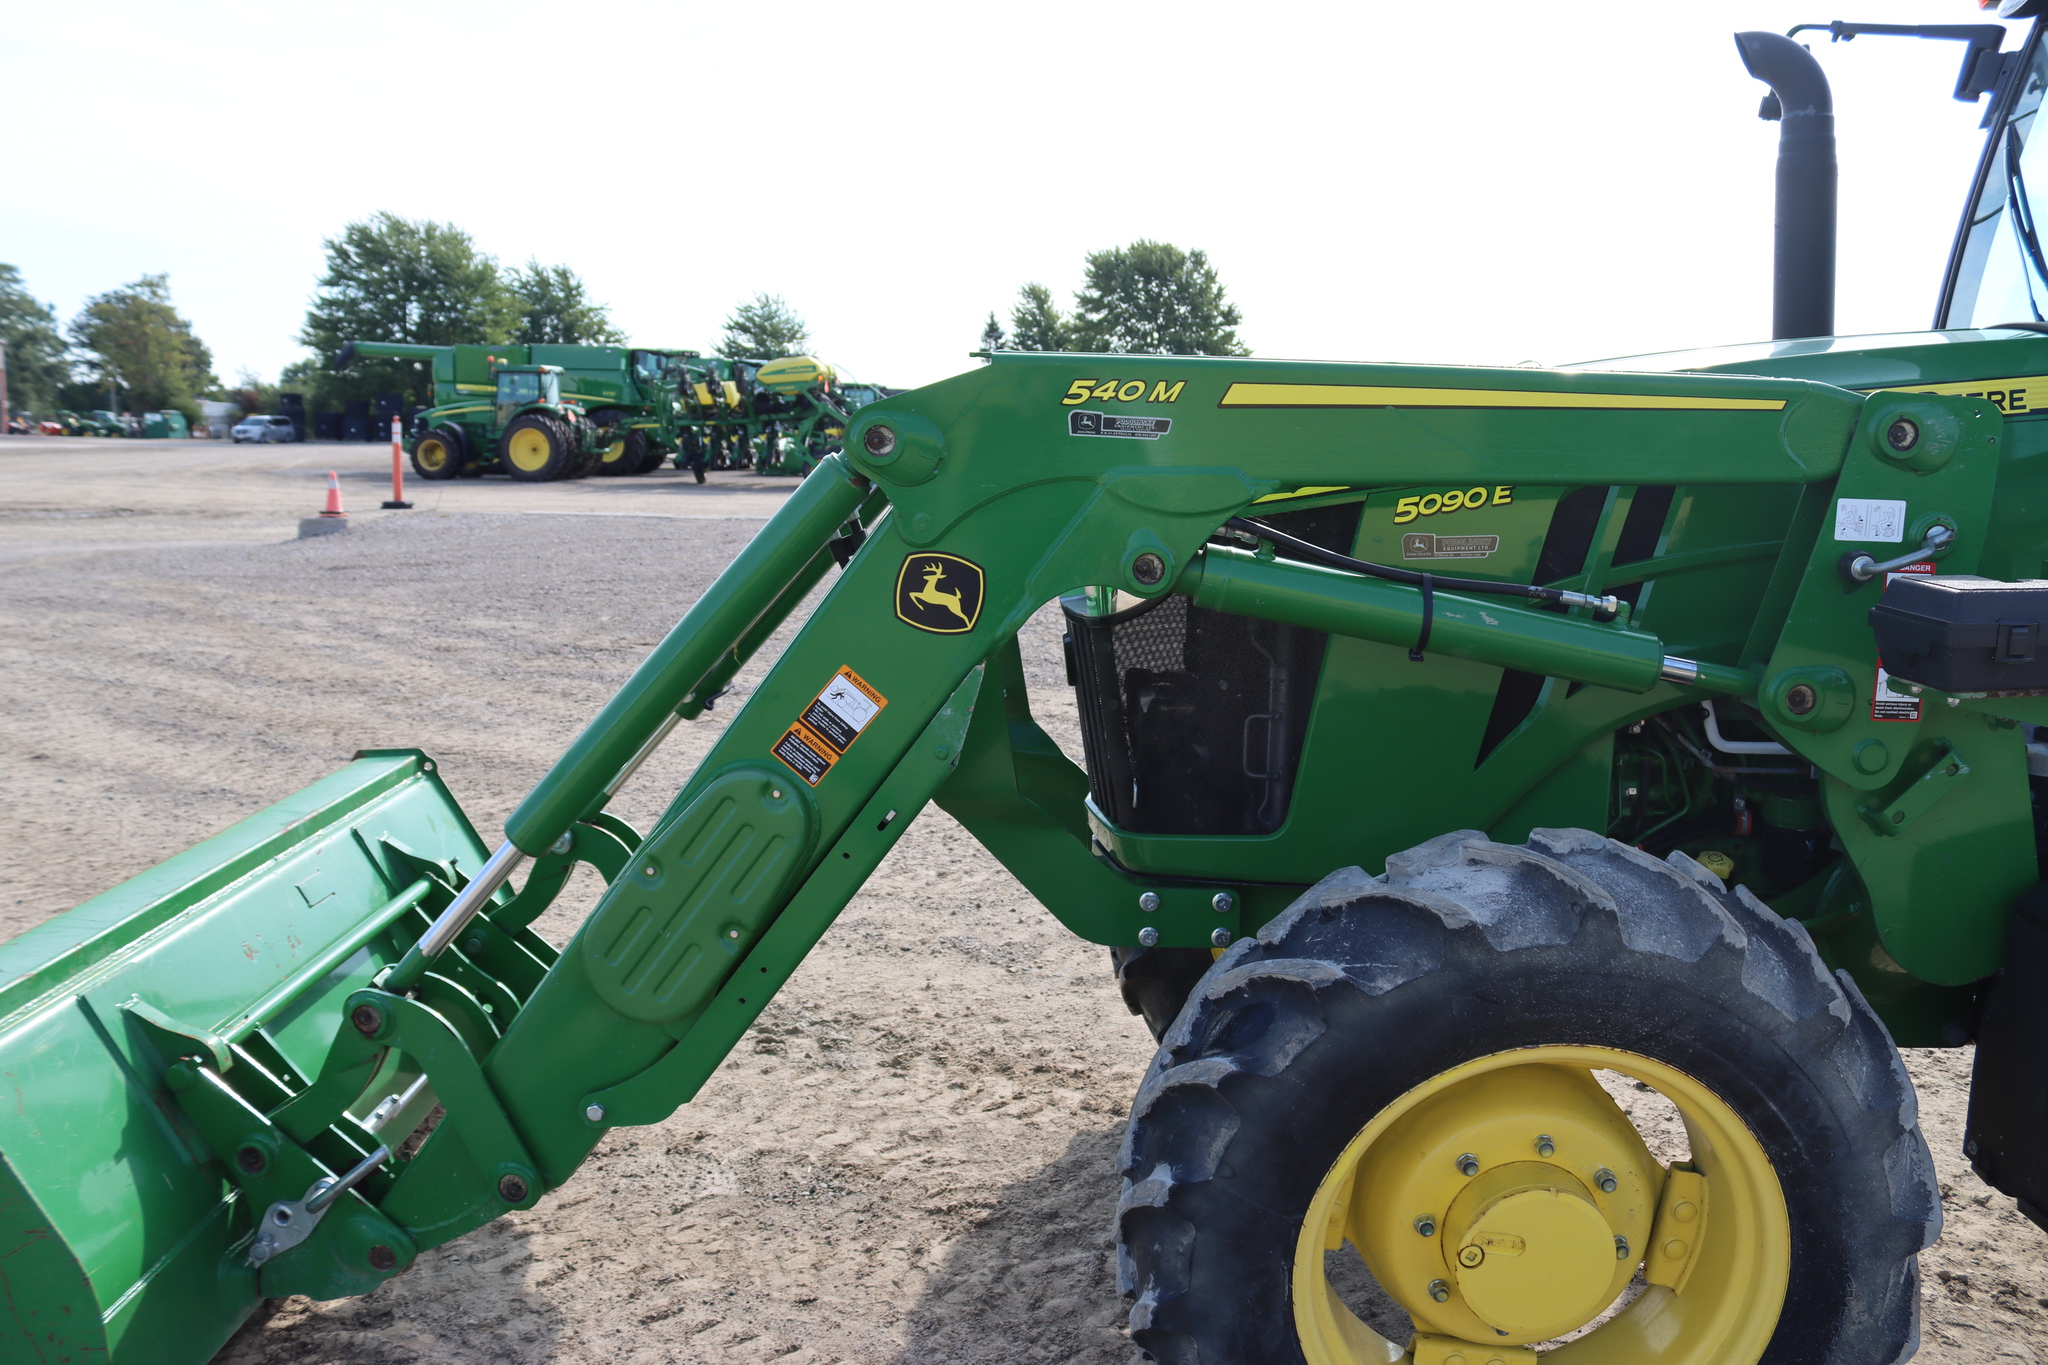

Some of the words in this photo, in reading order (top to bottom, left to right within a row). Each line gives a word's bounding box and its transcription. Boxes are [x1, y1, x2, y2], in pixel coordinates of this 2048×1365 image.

[1060, 379, 1147, 406] 540
[1146, 380, 1188, 403] M
[1393, 486, 1488, 525] 5090
[1492, 485, 1516, 507] E
[1442, 538, 1492, 546] PODOLINSKY
[852, 676, 882, 703] WARNING
[803, 733, 832, 760] WARNING
